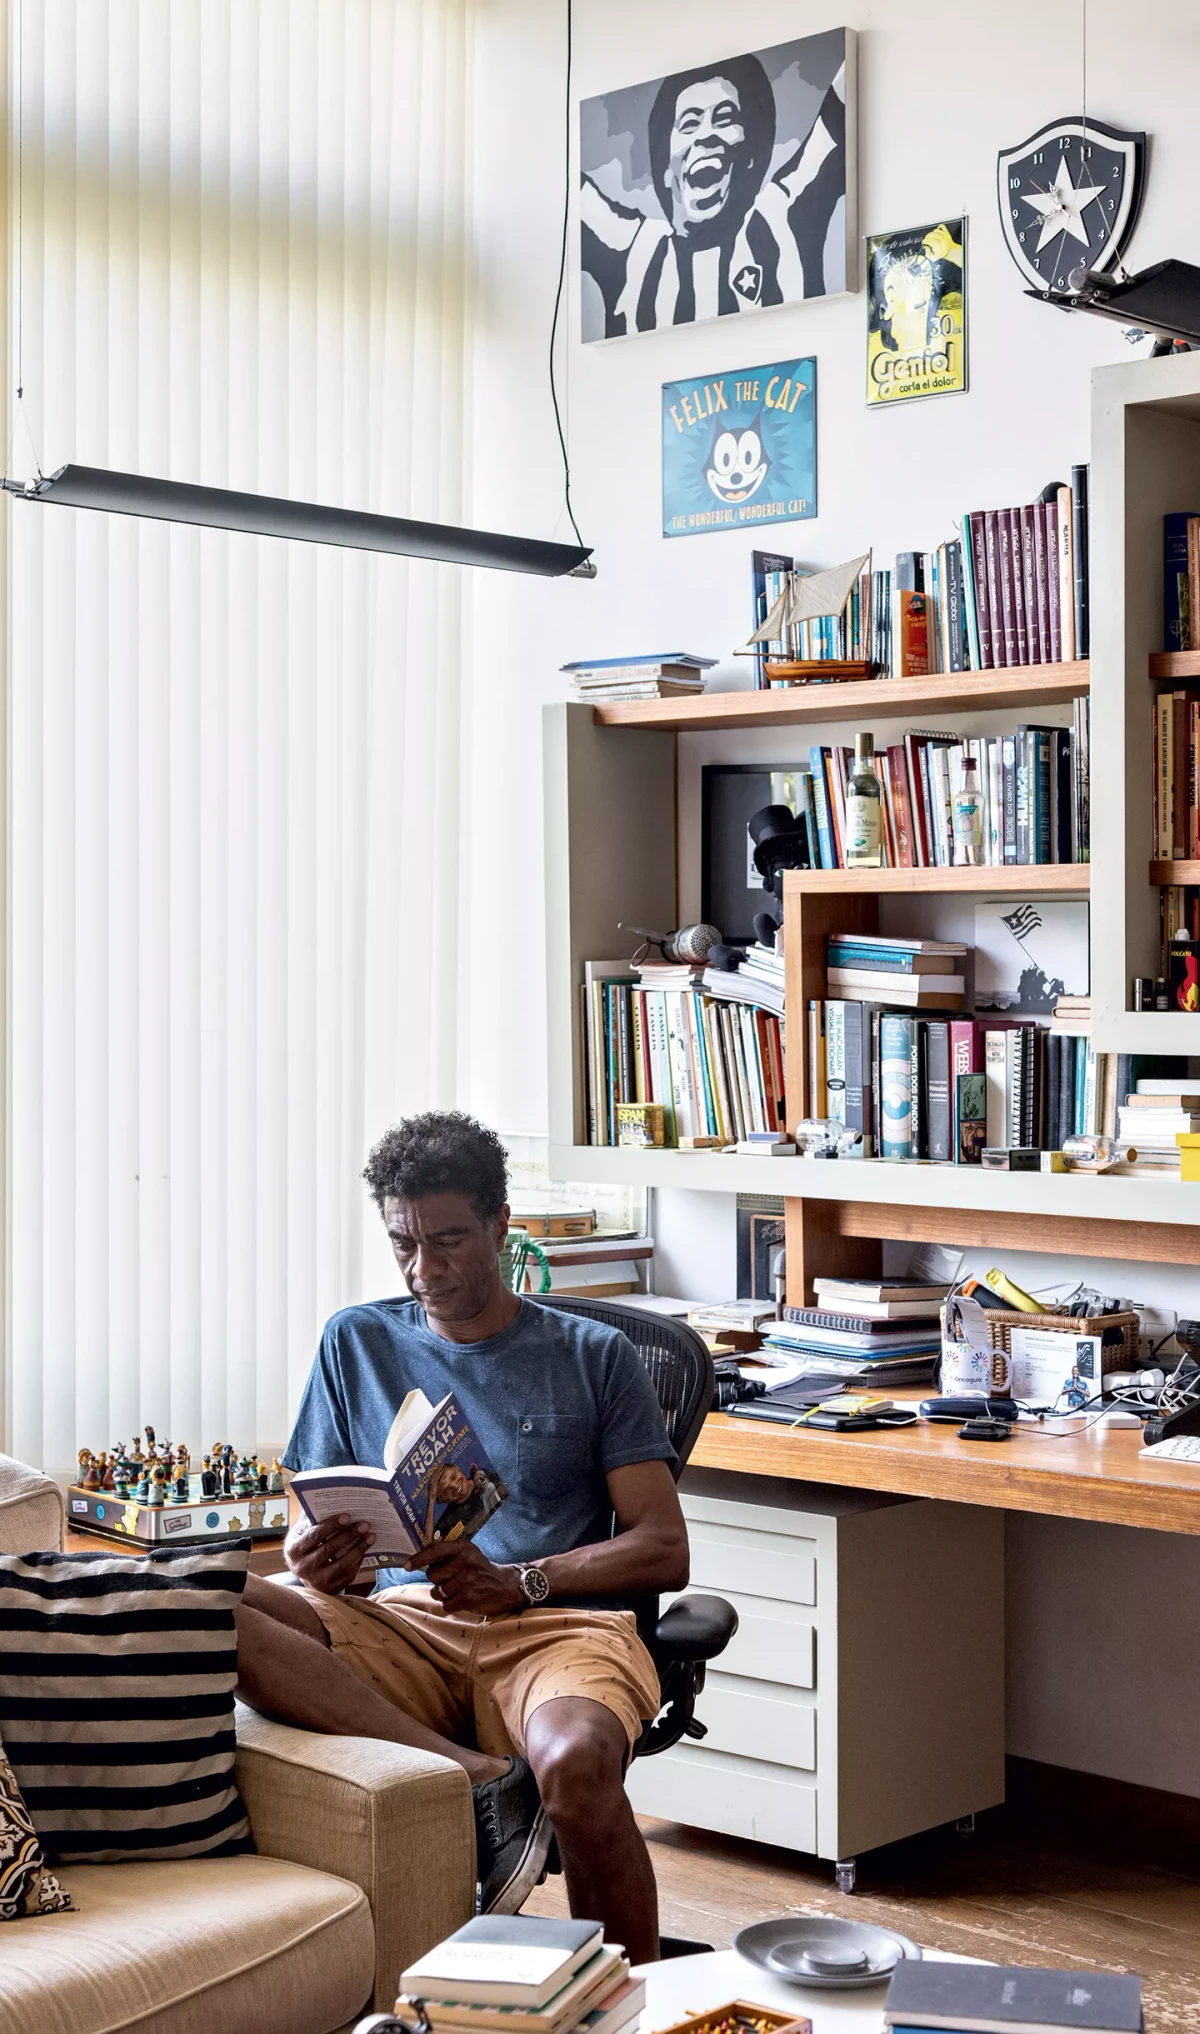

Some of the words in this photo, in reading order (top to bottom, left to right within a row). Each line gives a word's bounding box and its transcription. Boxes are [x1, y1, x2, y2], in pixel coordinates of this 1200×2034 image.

[1058, 138, 1071, 150] 12
[1033, 152, 1044, 165] 11
[1112, 166, 1120, 178] 2
[1010, 177, 1021, 190] 10
[1108, 200, 1115, 211] 3
[1012, 209, 1019, 221] 9
[1019, 232, 1026, 243] 8
[1098, 228, 1105, 240] 4
[1034, 258, 1041, 269] 7
[1080, 256, 1086, 268] 5
[1057, 276, 1065, 287] 6
[930, 314, 955, 338] 30
[900, 381, 920, 392] corta
[922, 379, 930, 389] el
[932, 376, 956, 388] dolor
[669, 380, 728, 433] FELIX
[735, 380, 760, 402] THE
[765, 376, 808, 414] CAT
[672, 516, 686, 529] THE
[688, 510, 736, 528] WONDERFUL,
[739, 501, 786, 520] WONDERFUL
[788, 498, 807, 514] CAT!
[950, 580, 956, 594] TV
[1017, 766, 1028, 826] HUMOR
[813, 778, 828, 829] BUSSUNDA
[1007, 803, 1013, 814] DO
[619, 1109, 646, 1120] SPAM
[402, 1404, 458, 1476] TREVOR
[415, 1425, 455, 1478] NOAH
[411, 1462, 437, 1500] NASCIDO
[437, 1451, 447, 1463] DO
[447, 1424, 470, 1453] CRIME
[393, 1480, 407, 1506] TREVOR
[405, 1504, 416, 1523] NOAH
